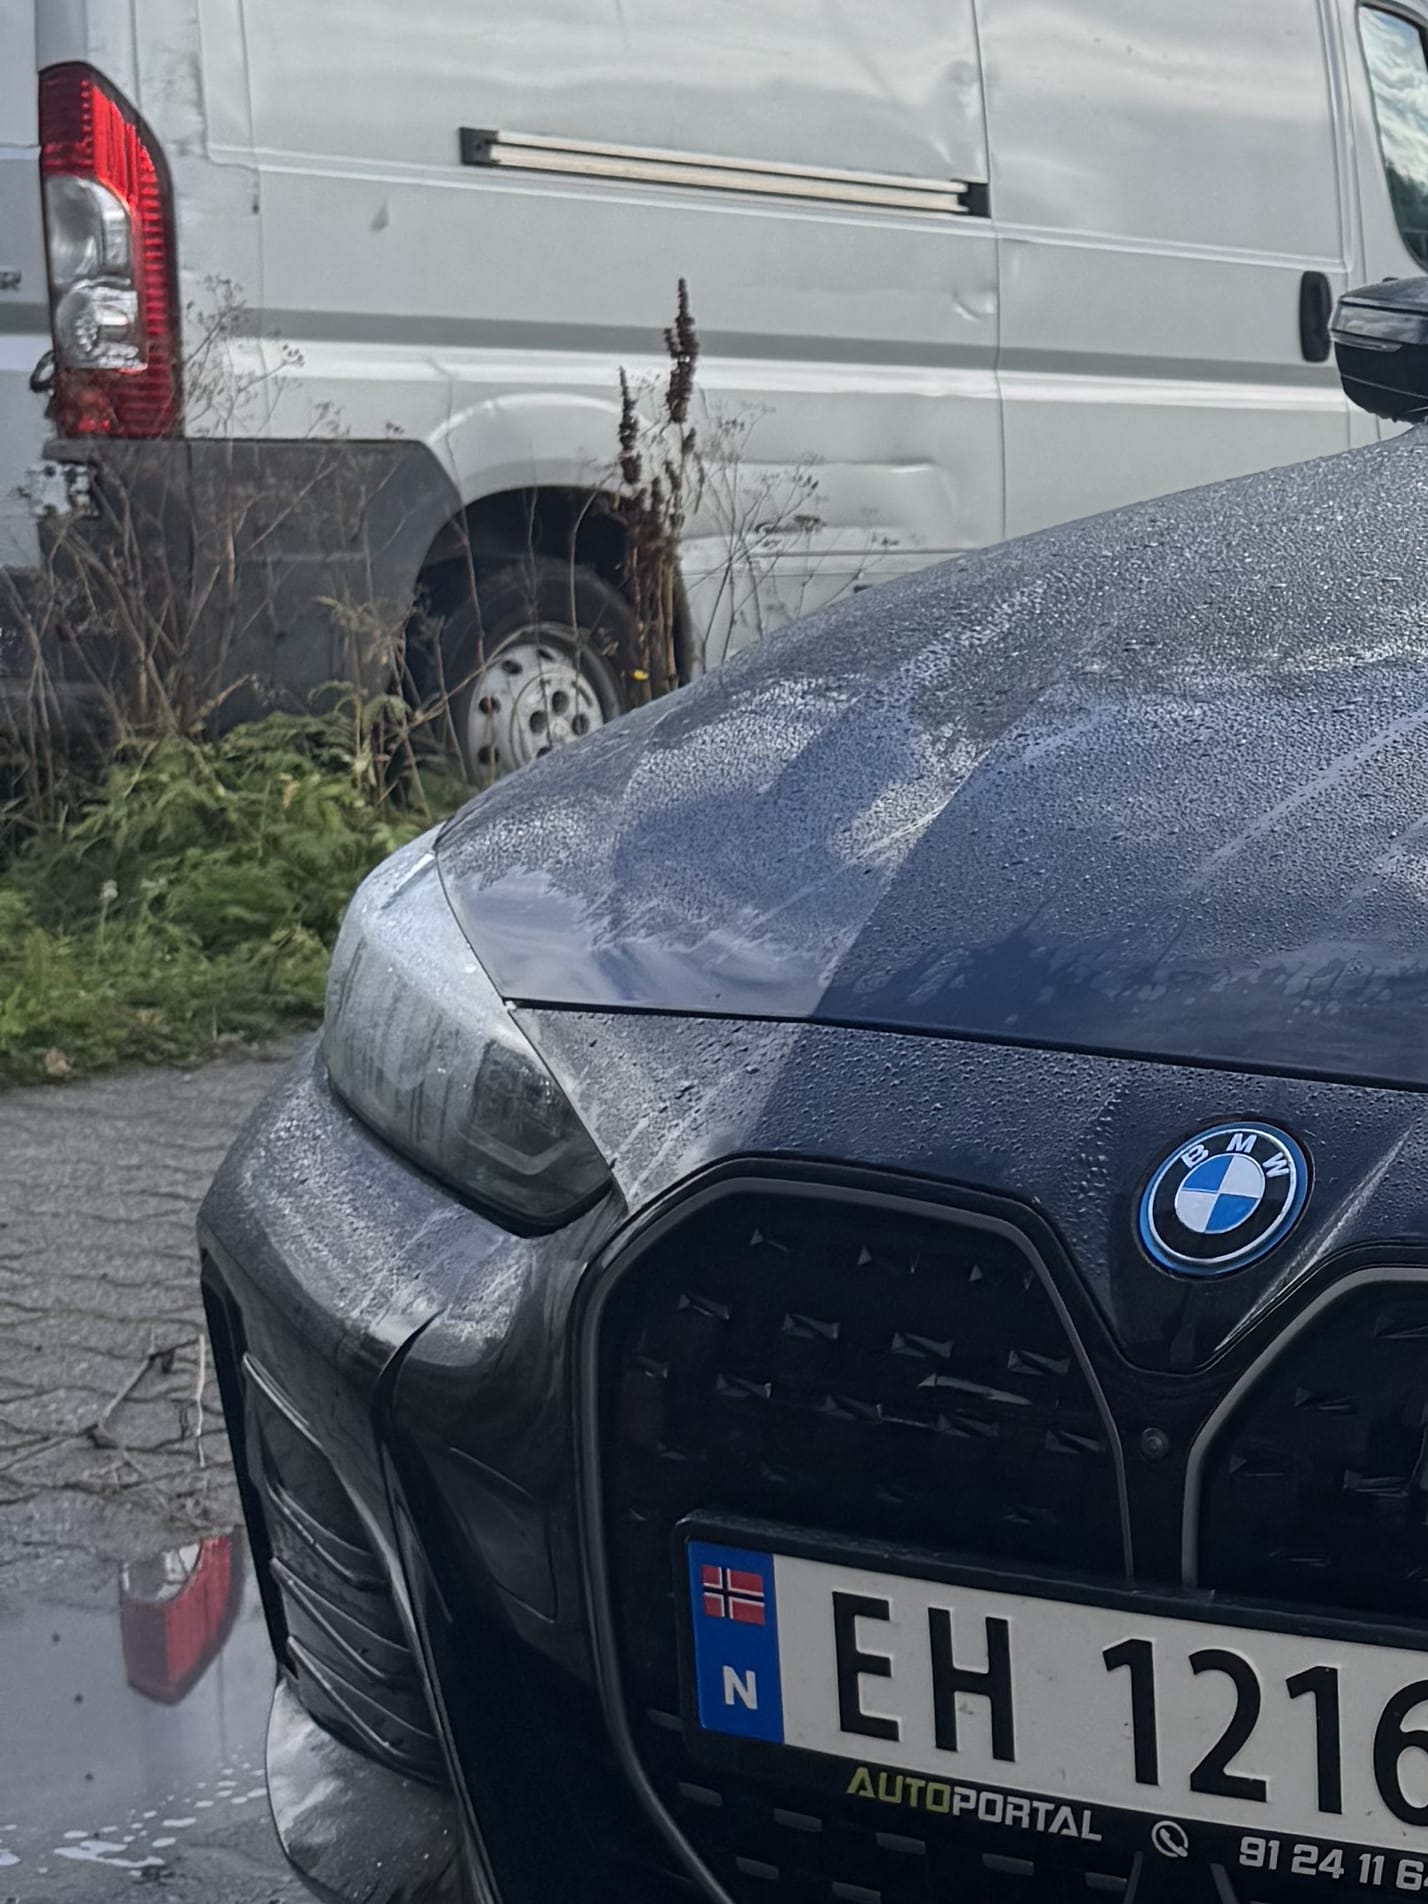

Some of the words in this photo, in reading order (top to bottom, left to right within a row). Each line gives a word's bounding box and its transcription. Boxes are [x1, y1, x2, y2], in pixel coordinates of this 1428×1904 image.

[1180, 1132, 1290, 1178] BMW
[722, 1664, 758, 1710] N
[832, 1590, 1016, 1763] EH
[846, 1766, 1103, 1842] AUTOPORTAL
[1239, 1836, 1281, 1871] 91
[1291, 1844, 1345, 1880] 24
[1359, 1853, 1385, 1886] 11
